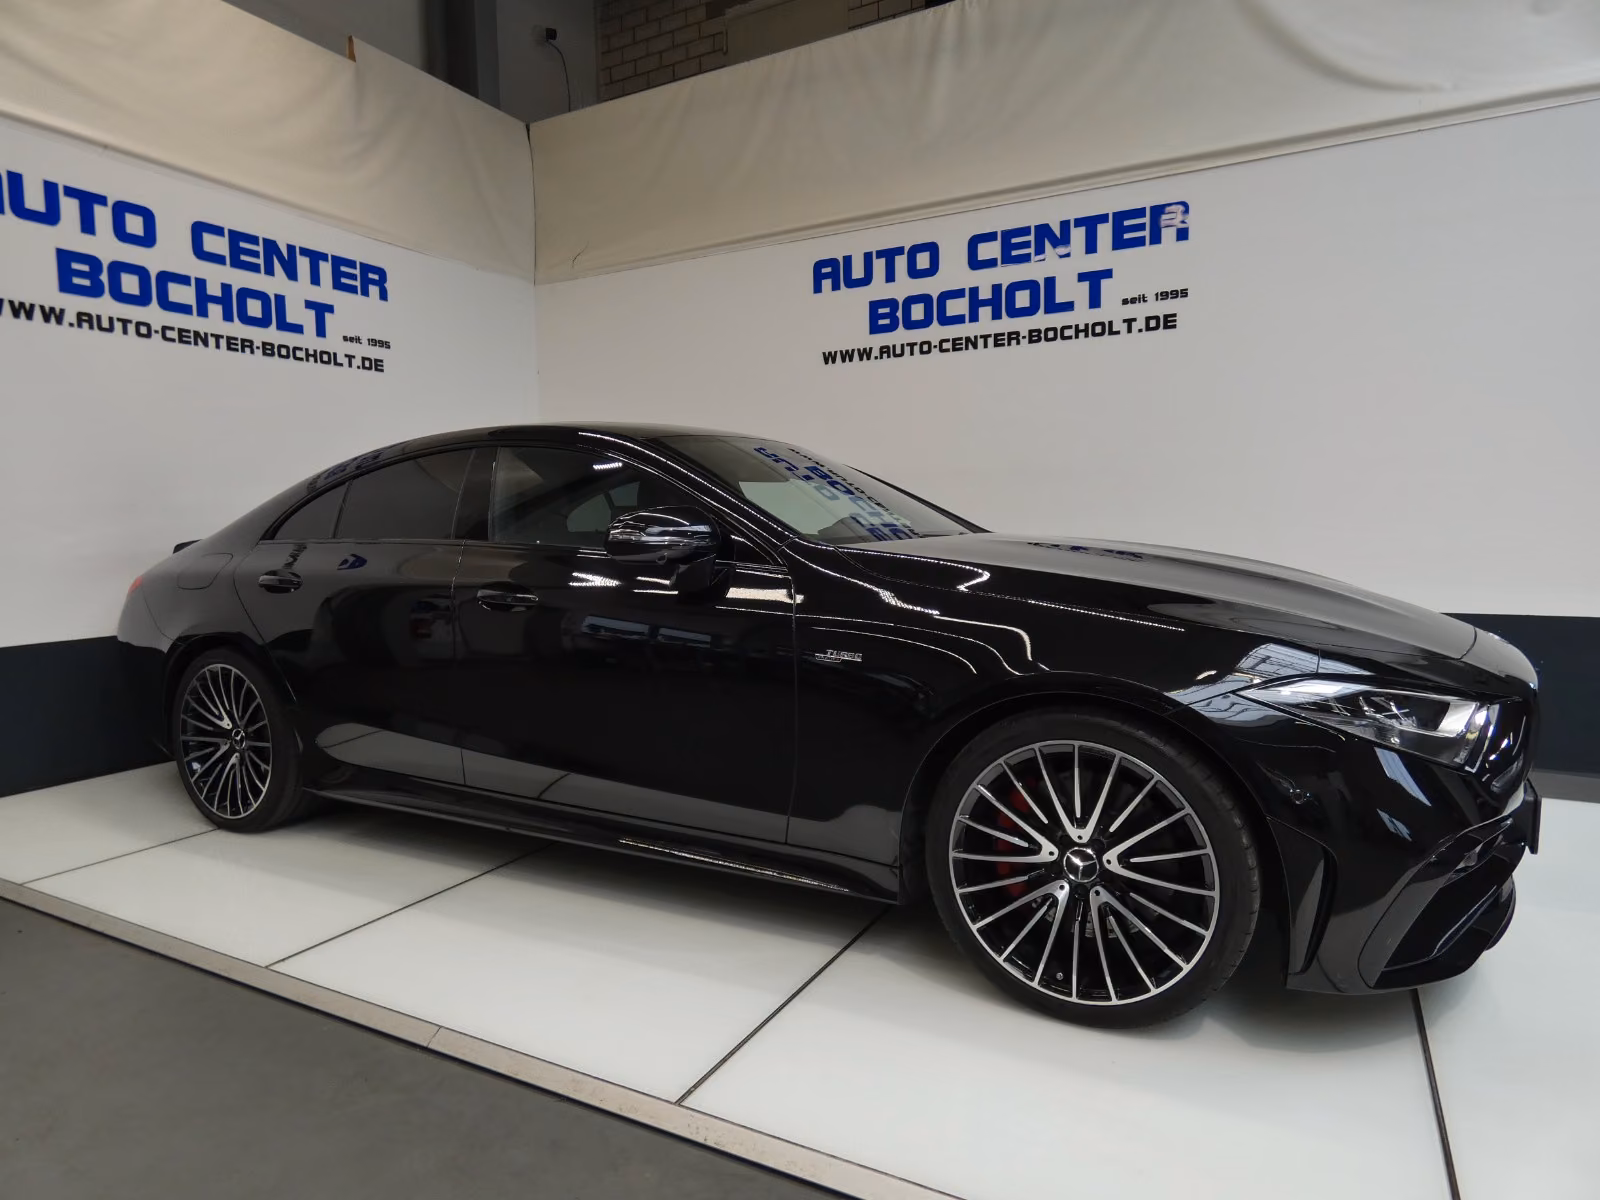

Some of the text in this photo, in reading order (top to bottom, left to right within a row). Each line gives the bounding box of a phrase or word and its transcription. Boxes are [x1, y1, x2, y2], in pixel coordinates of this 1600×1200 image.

[0, 169, 389, 302] UTO CENTER
[812, 200, 1190, 294] AUTO CENTER
[56, 247, 335, 338] BOCHOLT
[869, 268, 1113, 335] BOCHOLT
[1121, 288, 1189, 306] seit 1995
[0, 298, 385, 373] WW.AUTO-CENTER-BOCHOLT.DE
[342, 334, 391, 350] seit 1995
[822, 313, 1178, 366] WWW.AUTO-CENTER-BOCHOLT.DE
